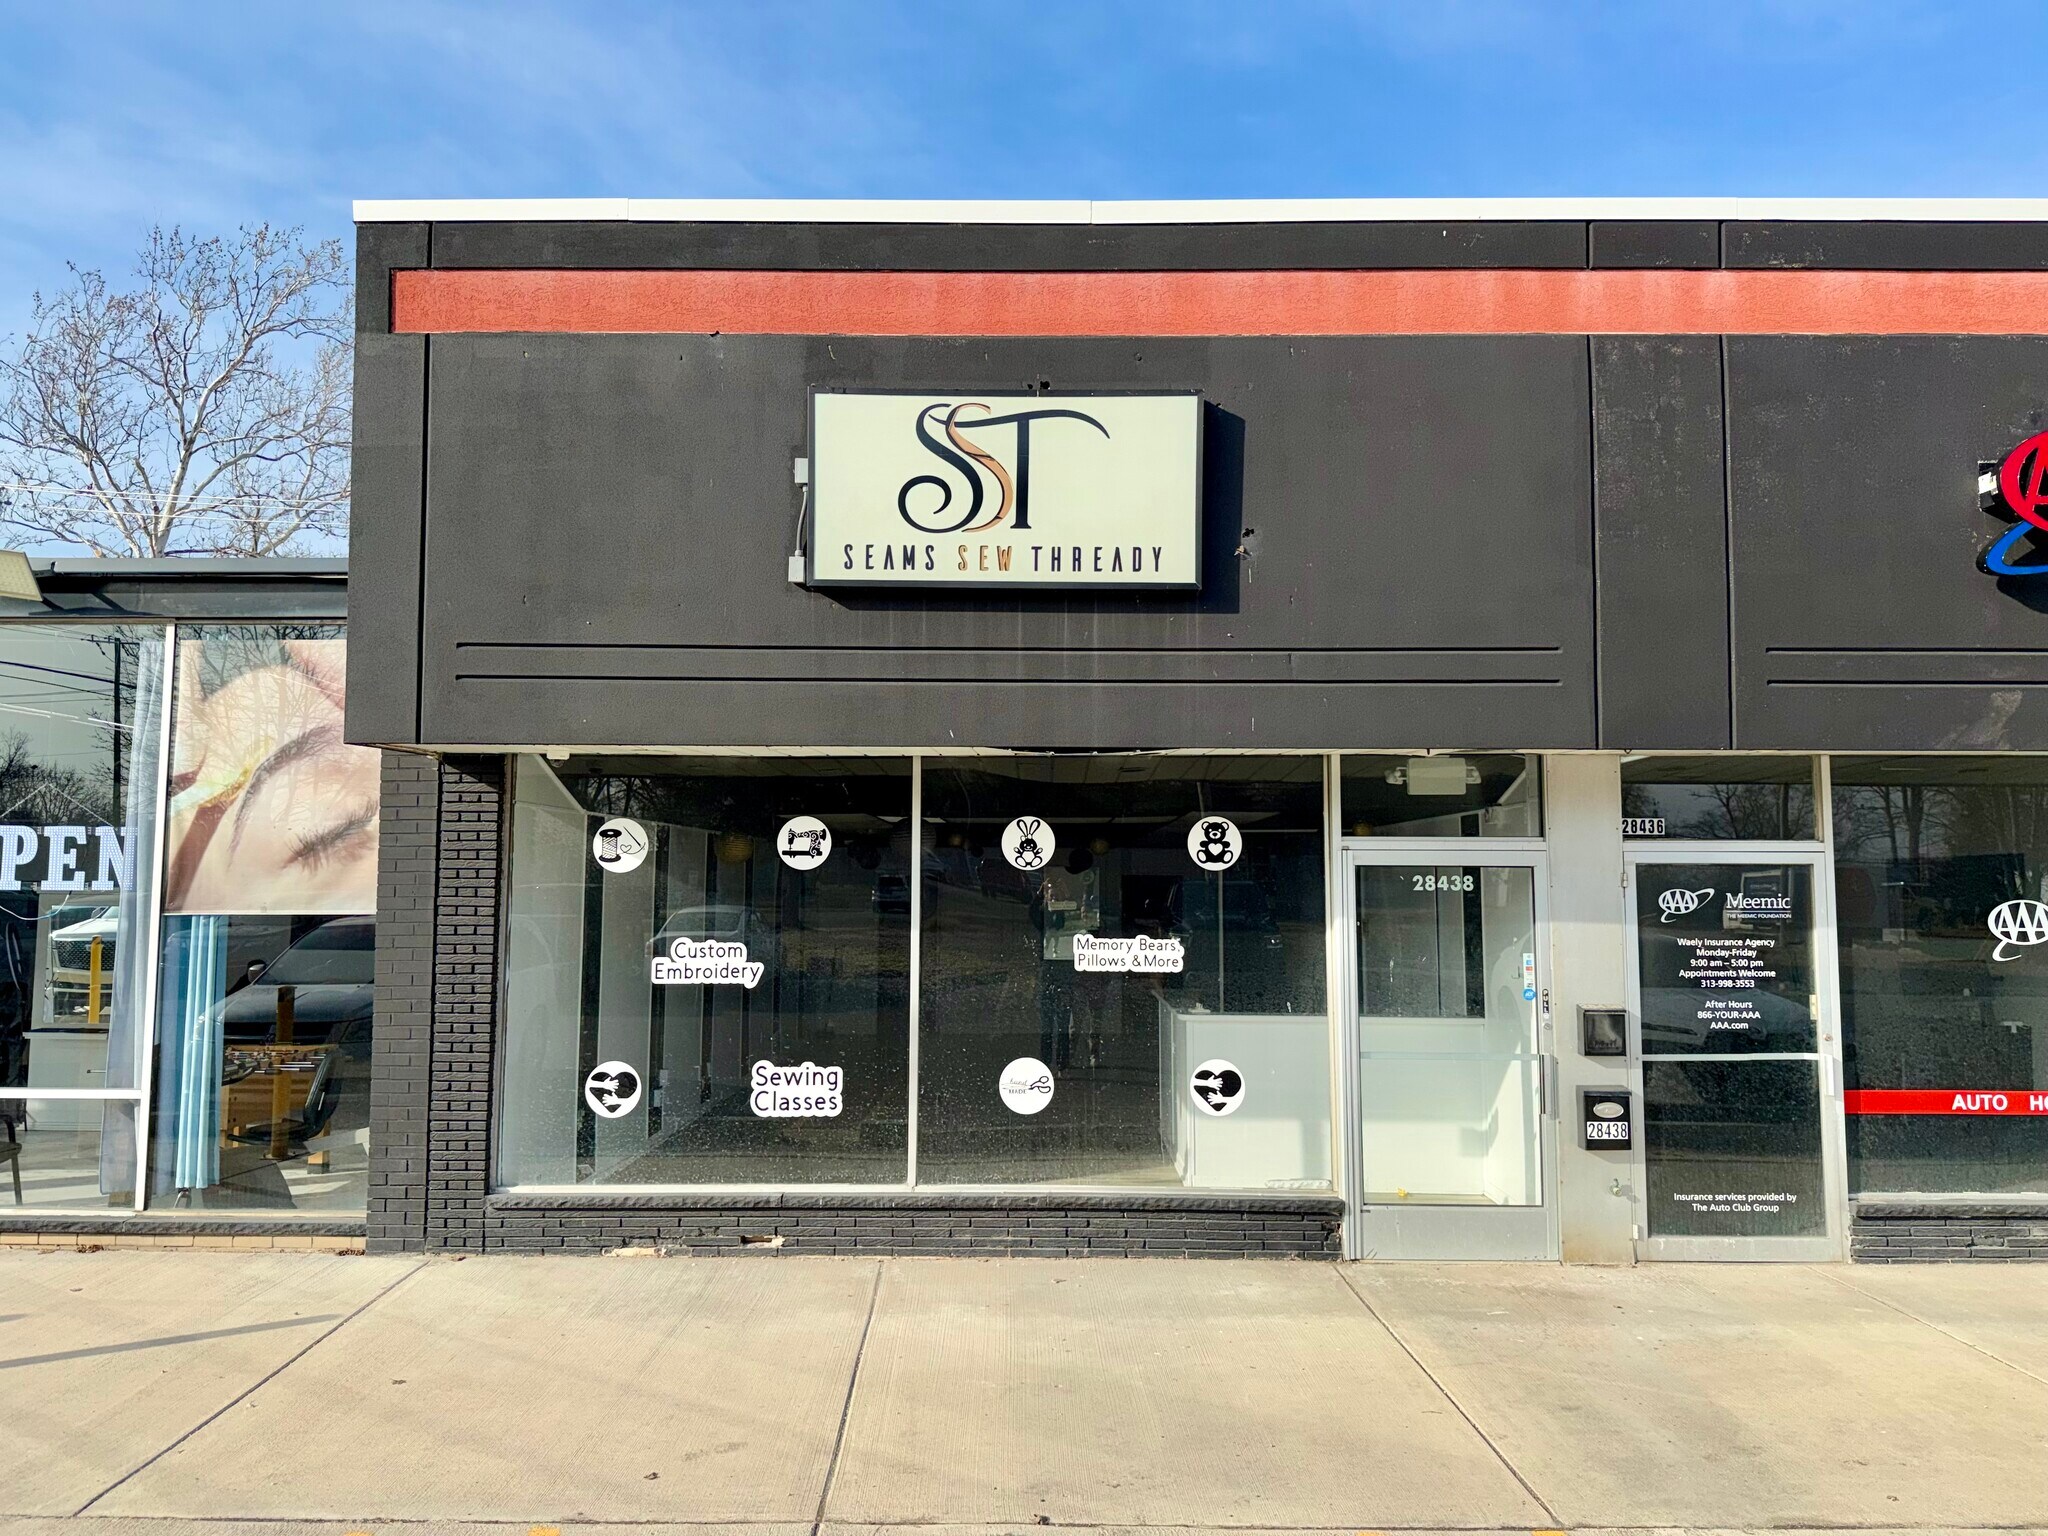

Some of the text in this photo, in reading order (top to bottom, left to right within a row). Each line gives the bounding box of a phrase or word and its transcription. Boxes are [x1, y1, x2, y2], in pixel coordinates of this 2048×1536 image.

[843, 543, 1163, 573] SEAMS SEW THREADY
[1622, 818, 1664, 834] 28436
[1412, 874, 1475, 892] 28438
[1663, 890, 1695, 913] AAA
[1726, 893, 1791, 909] Meemic
[674, 942, 743, 959] Custom
[1077, 938, 1133, 953] Memory
[1677, 938, 1775, 948] Waely Insurance Agency
[1078, 953, 1179, 967] Pillows & More
[1696, 948, 1757, 958] Monday-Friday
[1690, 959, 1708, 967] 9:00
[1731, 959, 1748, 967] 5:00
[1750, 960, 1764, 968] pm
[655, 962, 760, 983] Embroidery
[1679, 969, 1776, 979] Appointments Welcome
[1700, 980, 1755, 988] 313-998-3553
[1705, 1000, 1753, 1008] After Hours
[1697, 1011, 1761, 1019] 866-YOUR-AAA
[756, 1066, 838, 1091] Sewing
[755, 1091, 838, 1111] Classes
[1952, 1095, 2048, 1110] AUTO H
[1588, 1123, 1628, 1139] 28438
[1674, 1193, 1797, 1203] Insurance services provided by
[1692, 1203, 1780, 1213] The Auto Club Group
